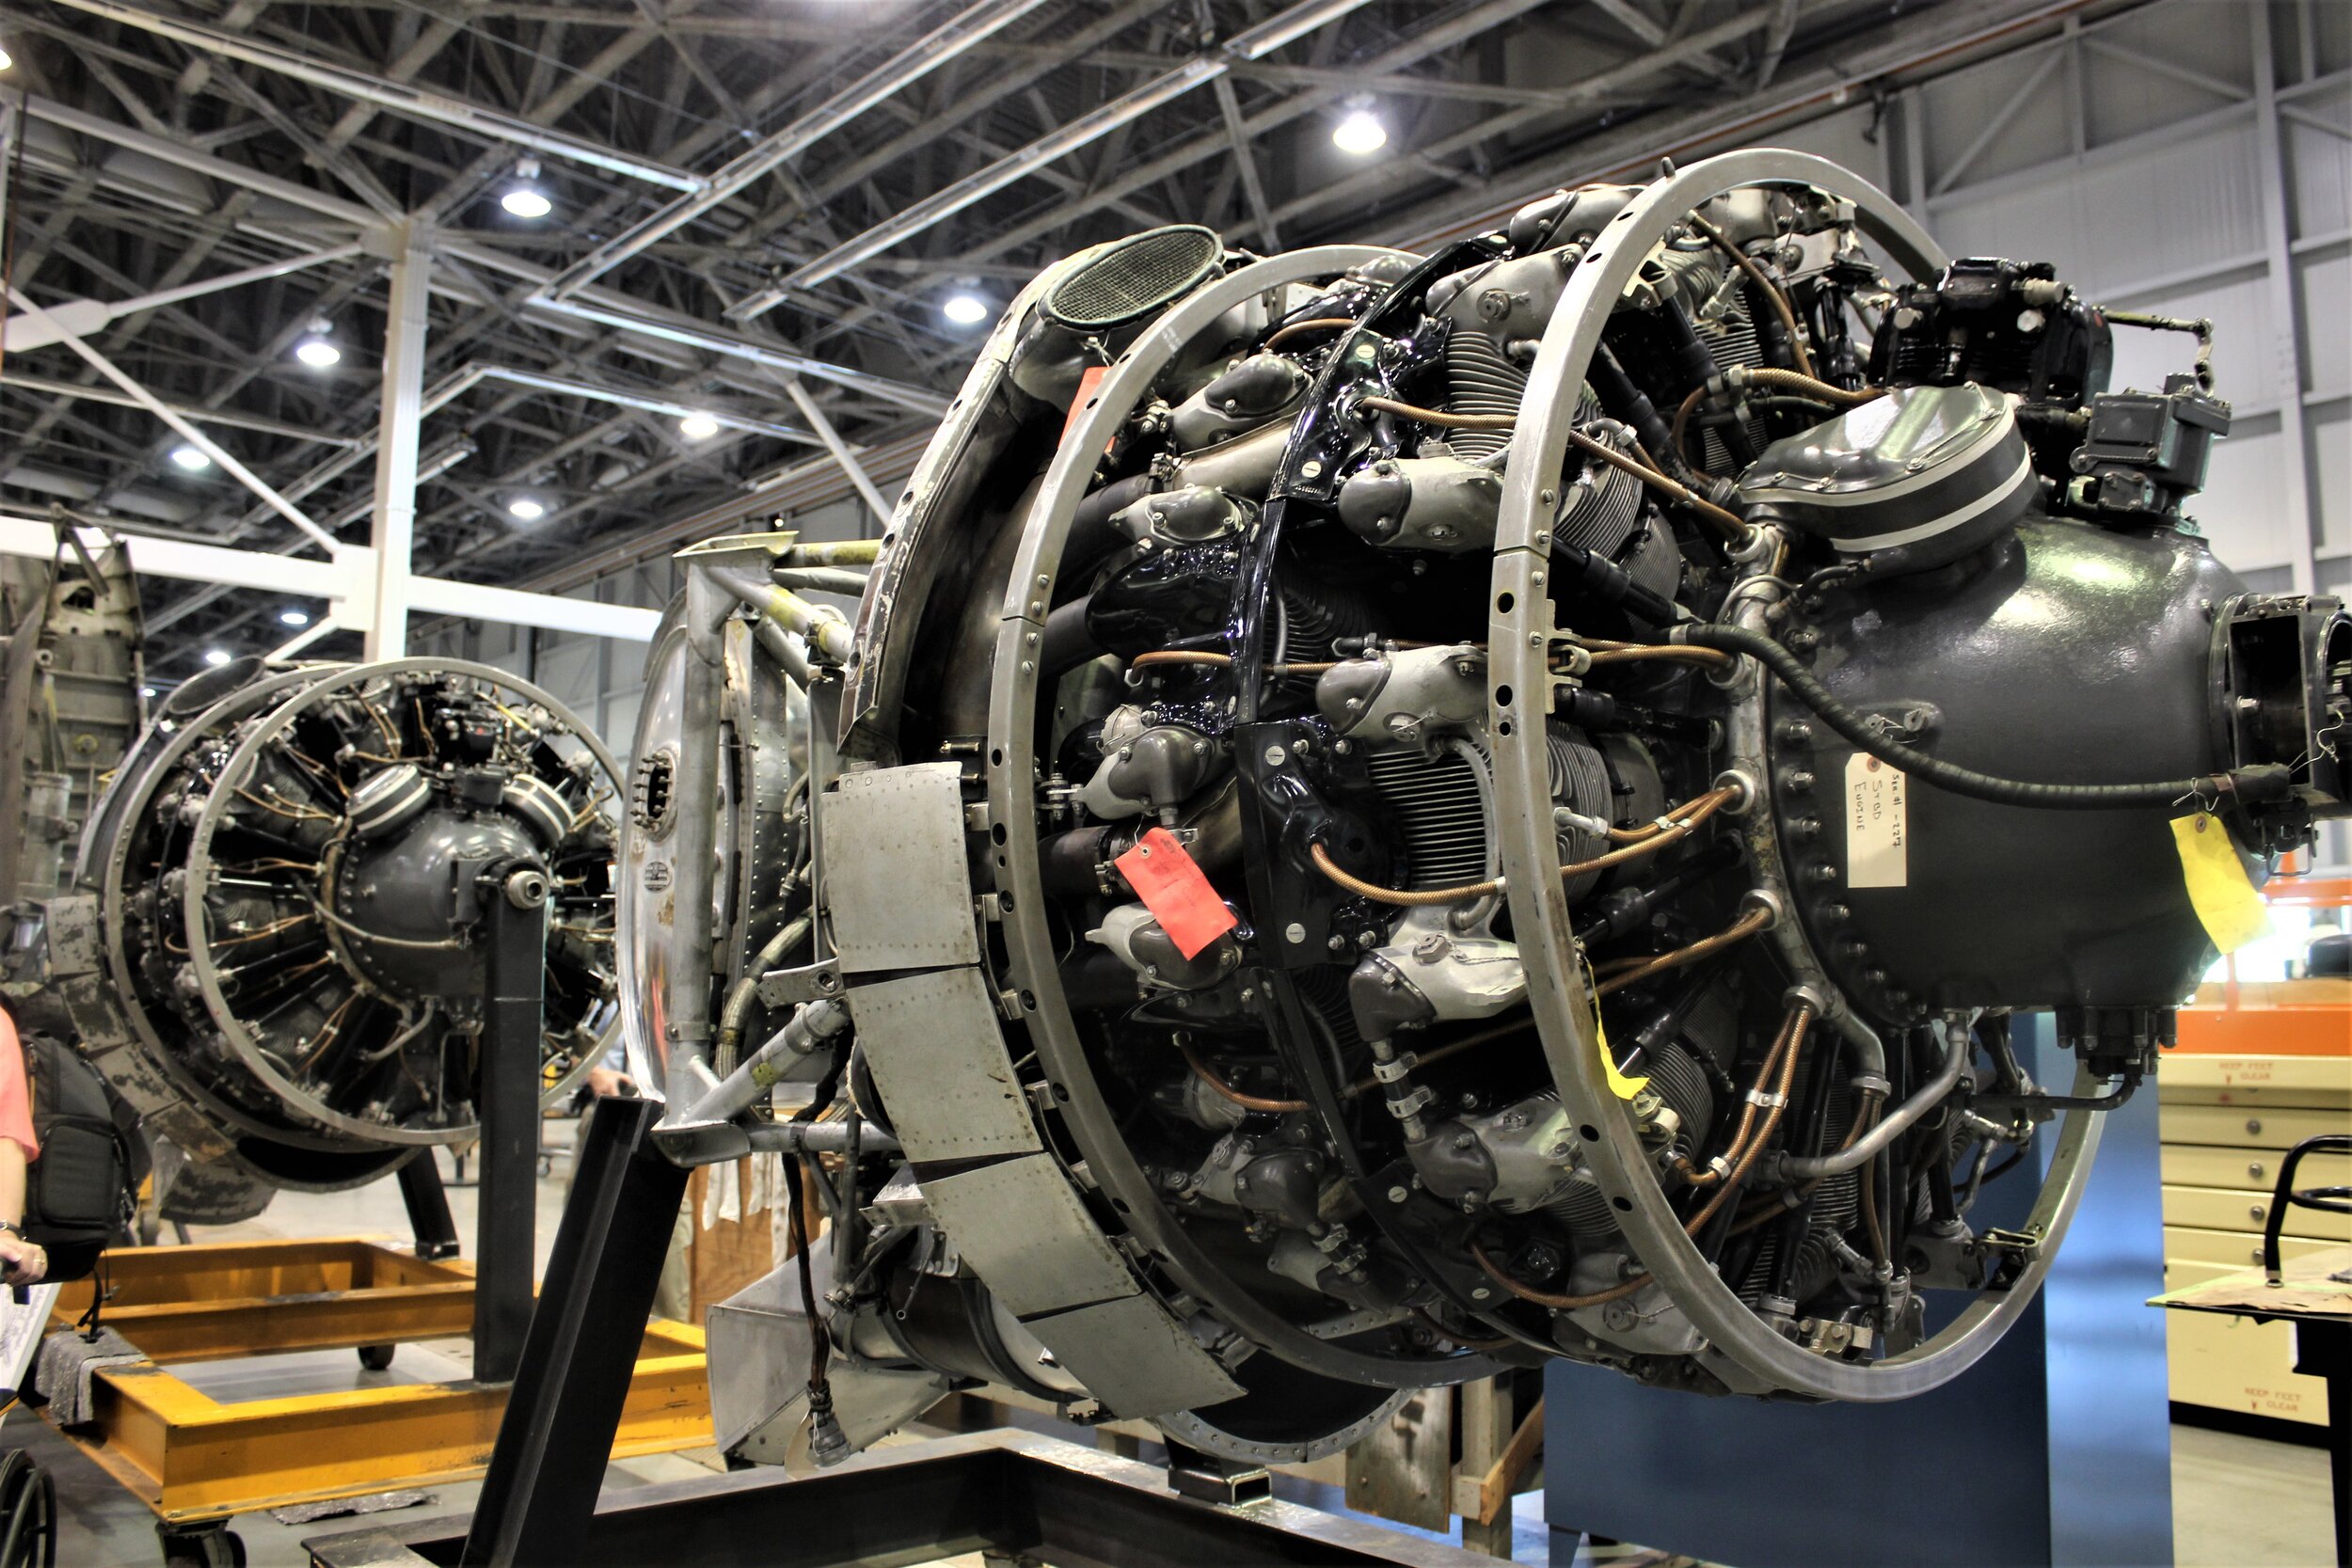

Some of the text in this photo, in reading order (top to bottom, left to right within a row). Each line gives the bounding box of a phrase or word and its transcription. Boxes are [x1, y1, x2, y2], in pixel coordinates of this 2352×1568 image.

[1854, 782, 1867, 832] ENGINE
[1872, 780, 1883, 820] STBD
[2266, 1401, 2298, 1411] CLEAR
[2275, 1392, 2301, 1402] FEET
